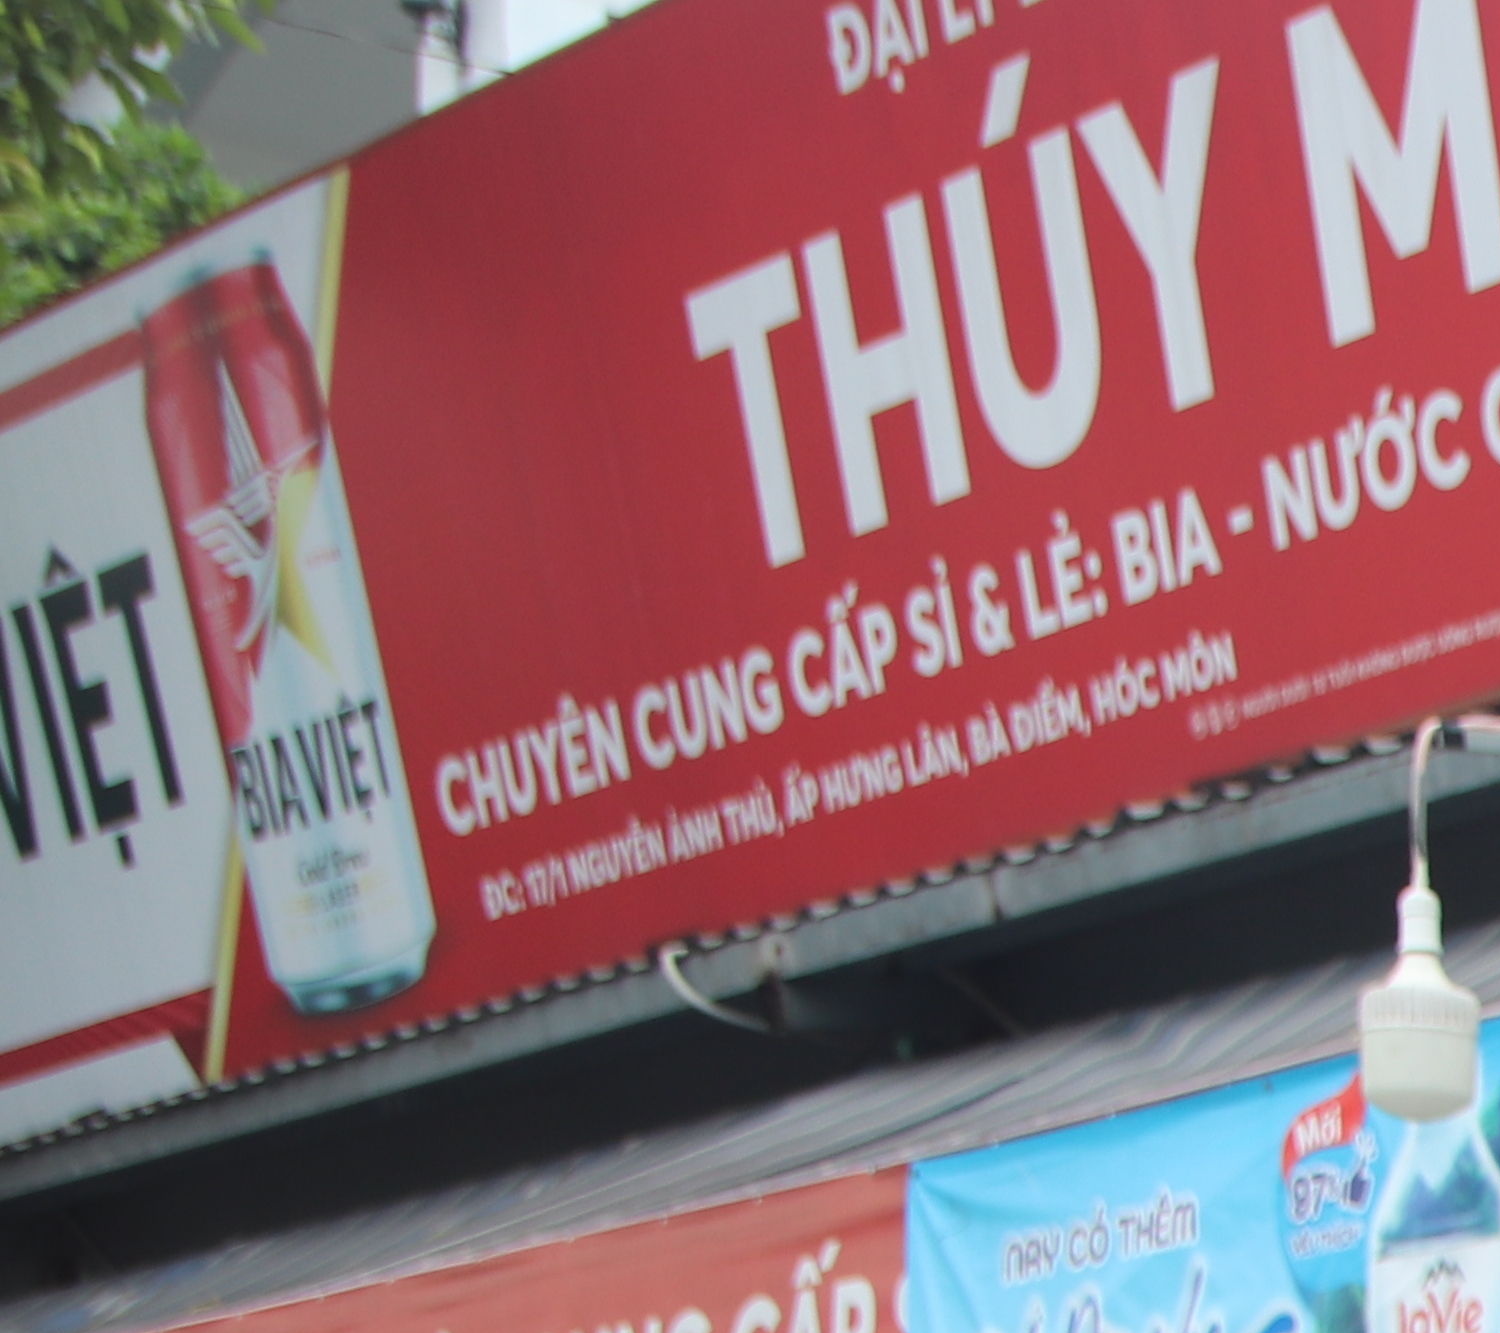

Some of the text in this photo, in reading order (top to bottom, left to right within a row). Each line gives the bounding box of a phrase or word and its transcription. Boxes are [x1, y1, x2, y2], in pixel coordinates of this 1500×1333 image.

[685, 50, 1220, 569] THÚY
[435, 691, 632, 837] CHUYÊN
[633, 645, 785, 770] CUNG
[788, 578, 897, 717] CẤP
[905, 553, 963, 678] SỈ
[969, 561, 1016, 658] &
[1015, 507, 1108, 641] LẺ:
[1110, 486, 1223, 606] BIA
[1226, 504, 1254, 536] -
[1260, 382, 1472, 553] NƯỚC
[480, 866, 527, 922] ĐC:
[566, 813, 668, 897] NGUYỄN
[818, 742, 904, 815] HƯNG
[967, 700, 1011, 768] BÀ
[1089, 653, 1161, 727] HÓC
[1160, 628, 1239, 700] MÔN
[1006, 1190, 1198, 1282] NAY CÓ THÊM
[1295, 1103, 1343, 1155] Mới
